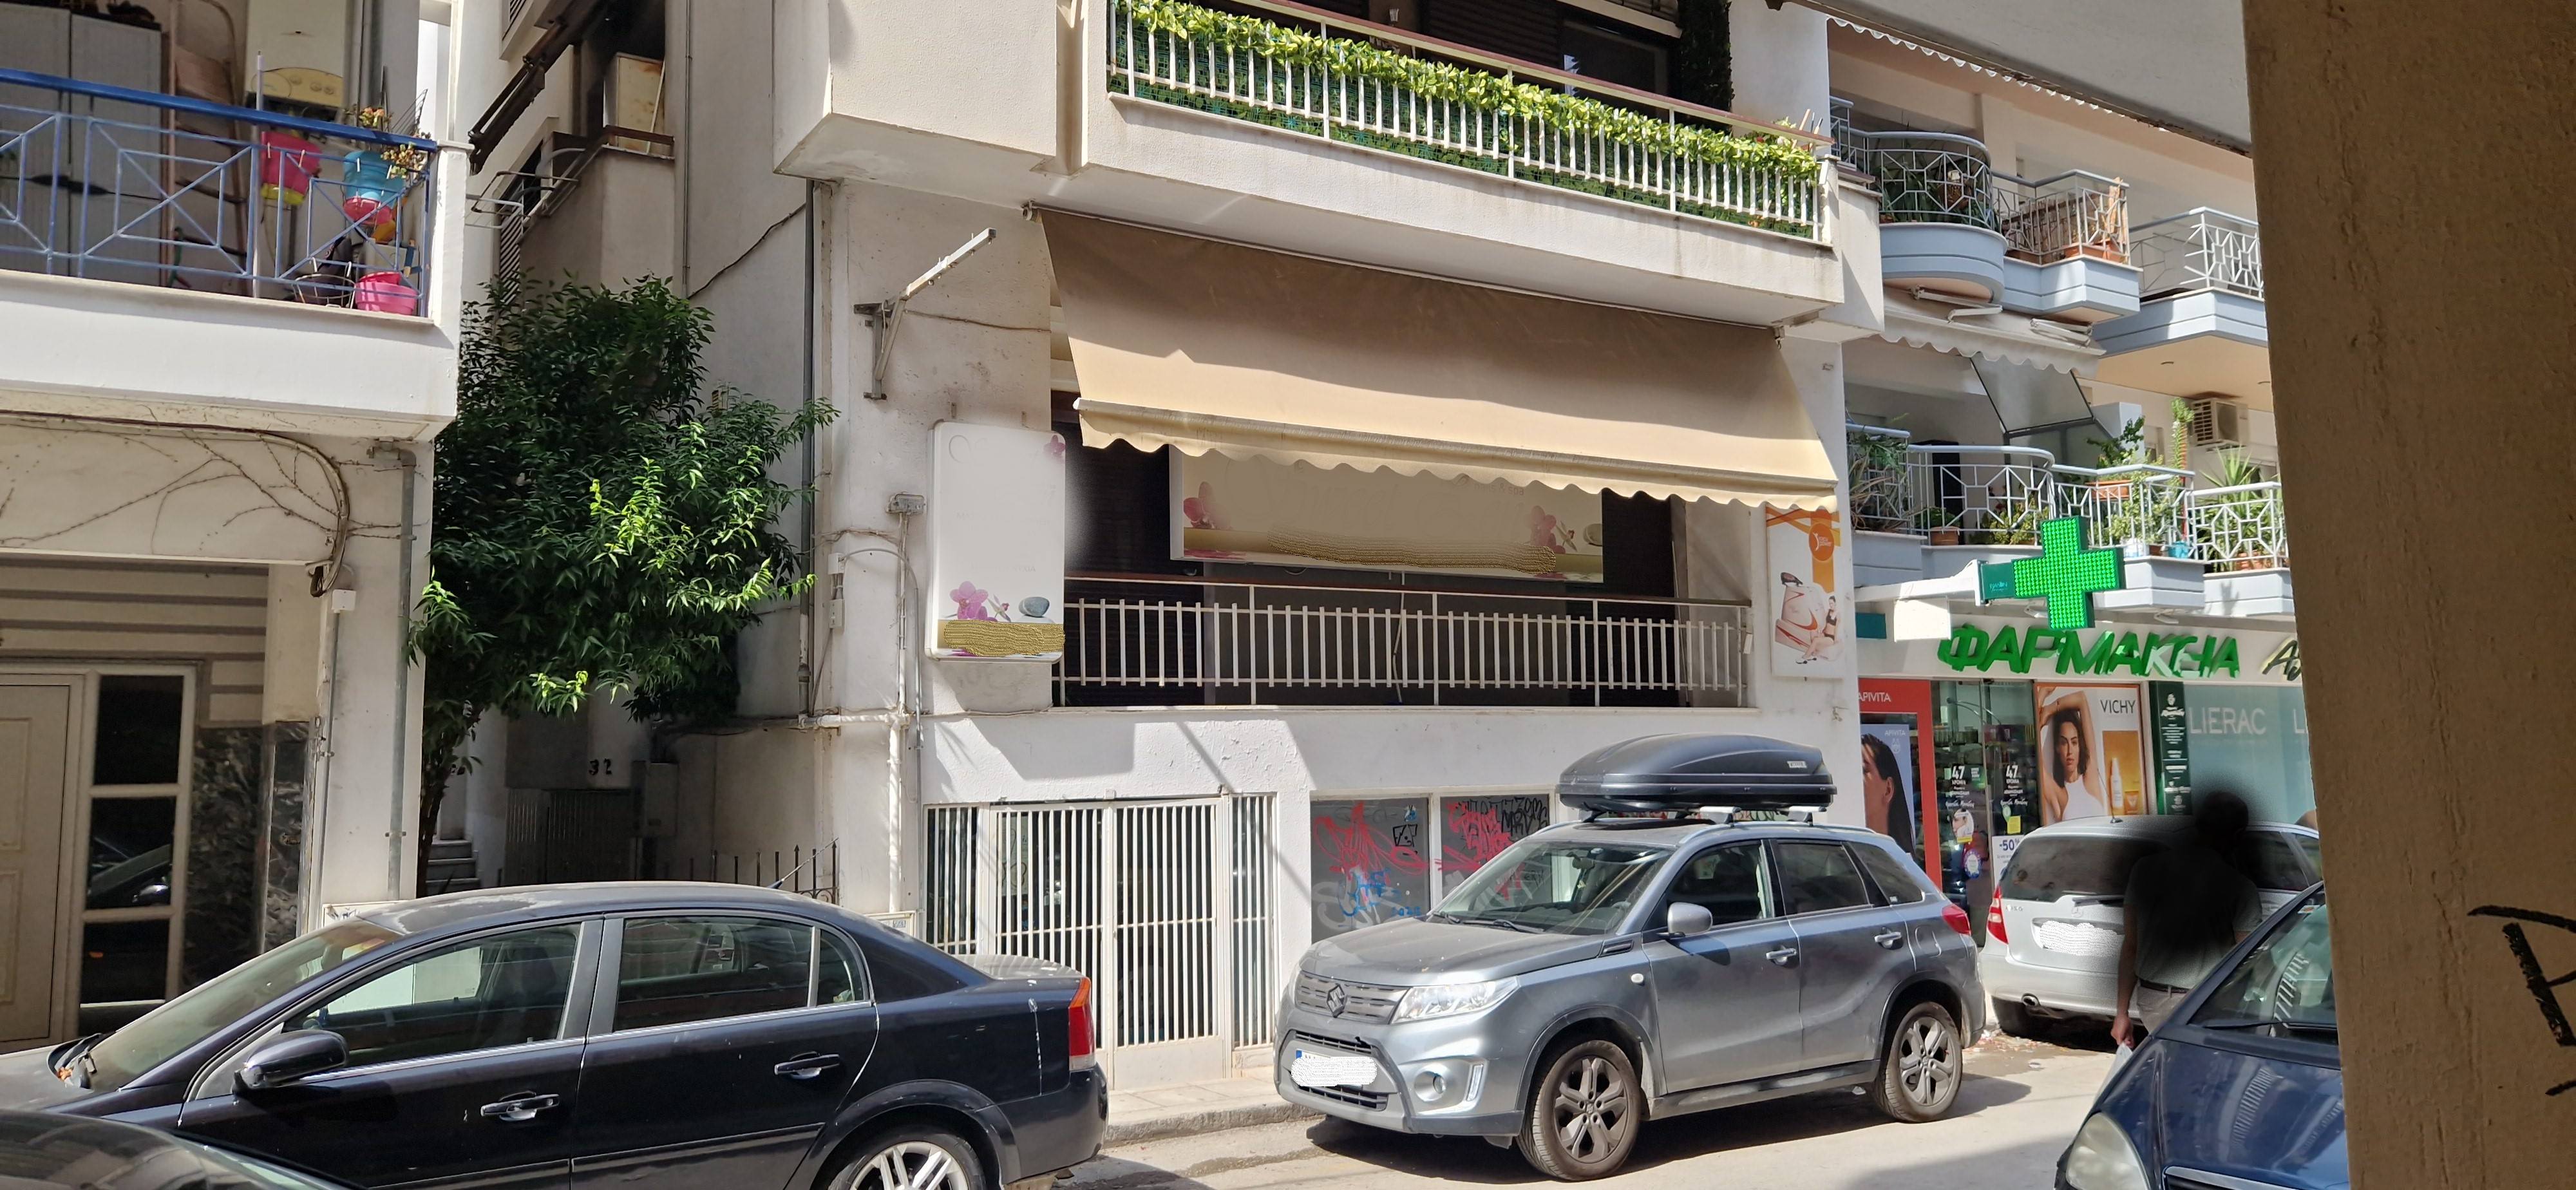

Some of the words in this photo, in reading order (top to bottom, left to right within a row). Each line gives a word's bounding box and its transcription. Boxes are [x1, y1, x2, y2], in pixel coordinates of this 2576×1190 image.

[1937, 622, 2240, 678] ΦΑΡΜΑΚΕΙΑ
[1858, 692, 1891, 703] APIVITA
[2100, 699, 2136, 714] VICHY
[2190, 706, 2268, 735] LIERAC
[589, 758, 612, 775] 32
[1952, 766, 1965, 780] 47
[2005, 764, 2019, 779] 47
